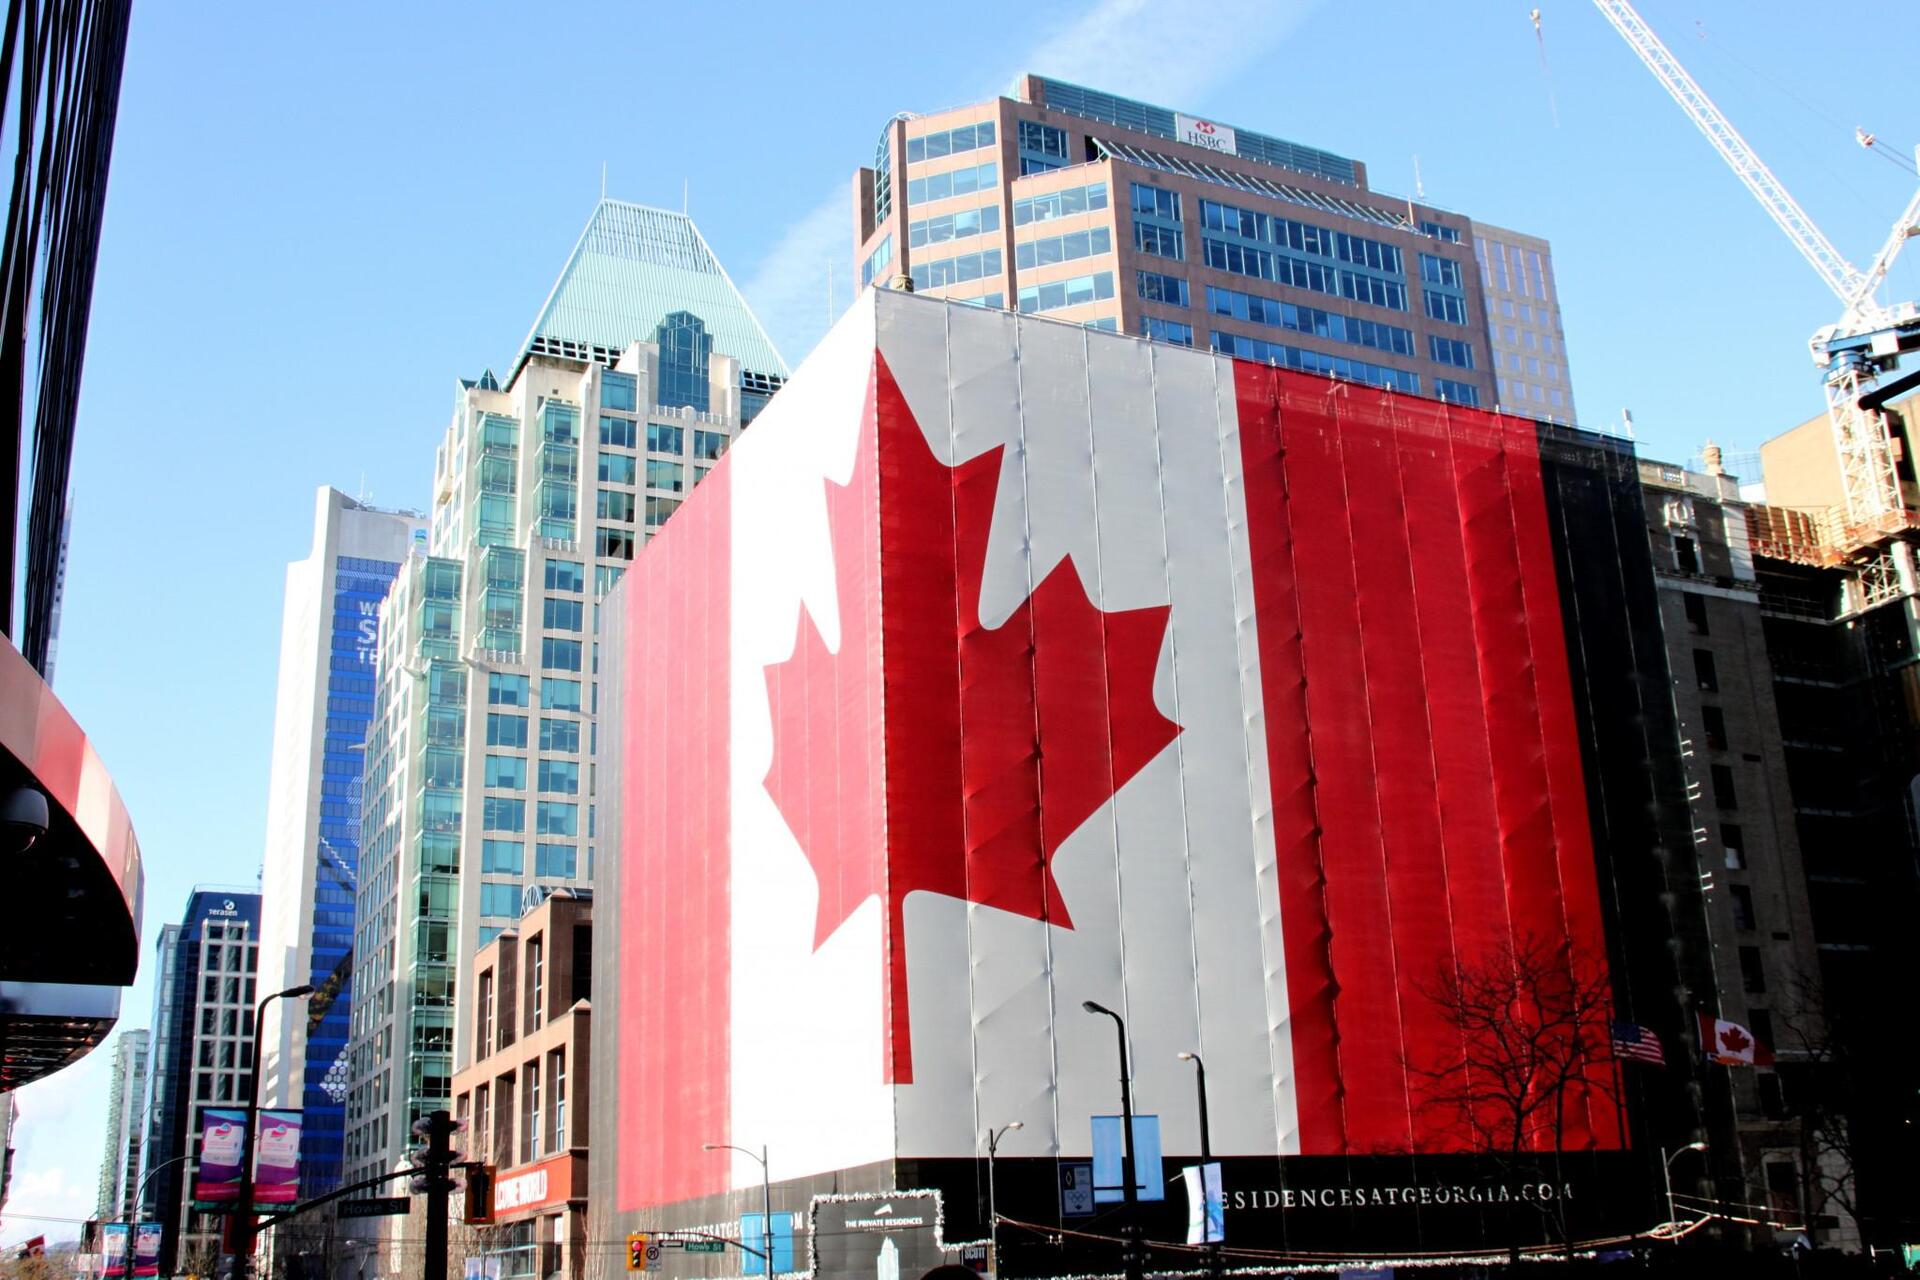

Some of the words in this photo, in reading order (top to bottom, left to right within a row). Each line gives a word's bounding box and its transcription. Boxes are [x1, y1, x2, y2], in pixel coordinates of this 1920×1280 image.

[1188, 131, 1226, 149] HSBC
[344, 1202, 383, 1215] Howe
[845, 1220, 857, 1229] THE
[858, 1219, 884, 1228] PRIVATE
[885, 1217, 923, 1226] RESIDENCES
